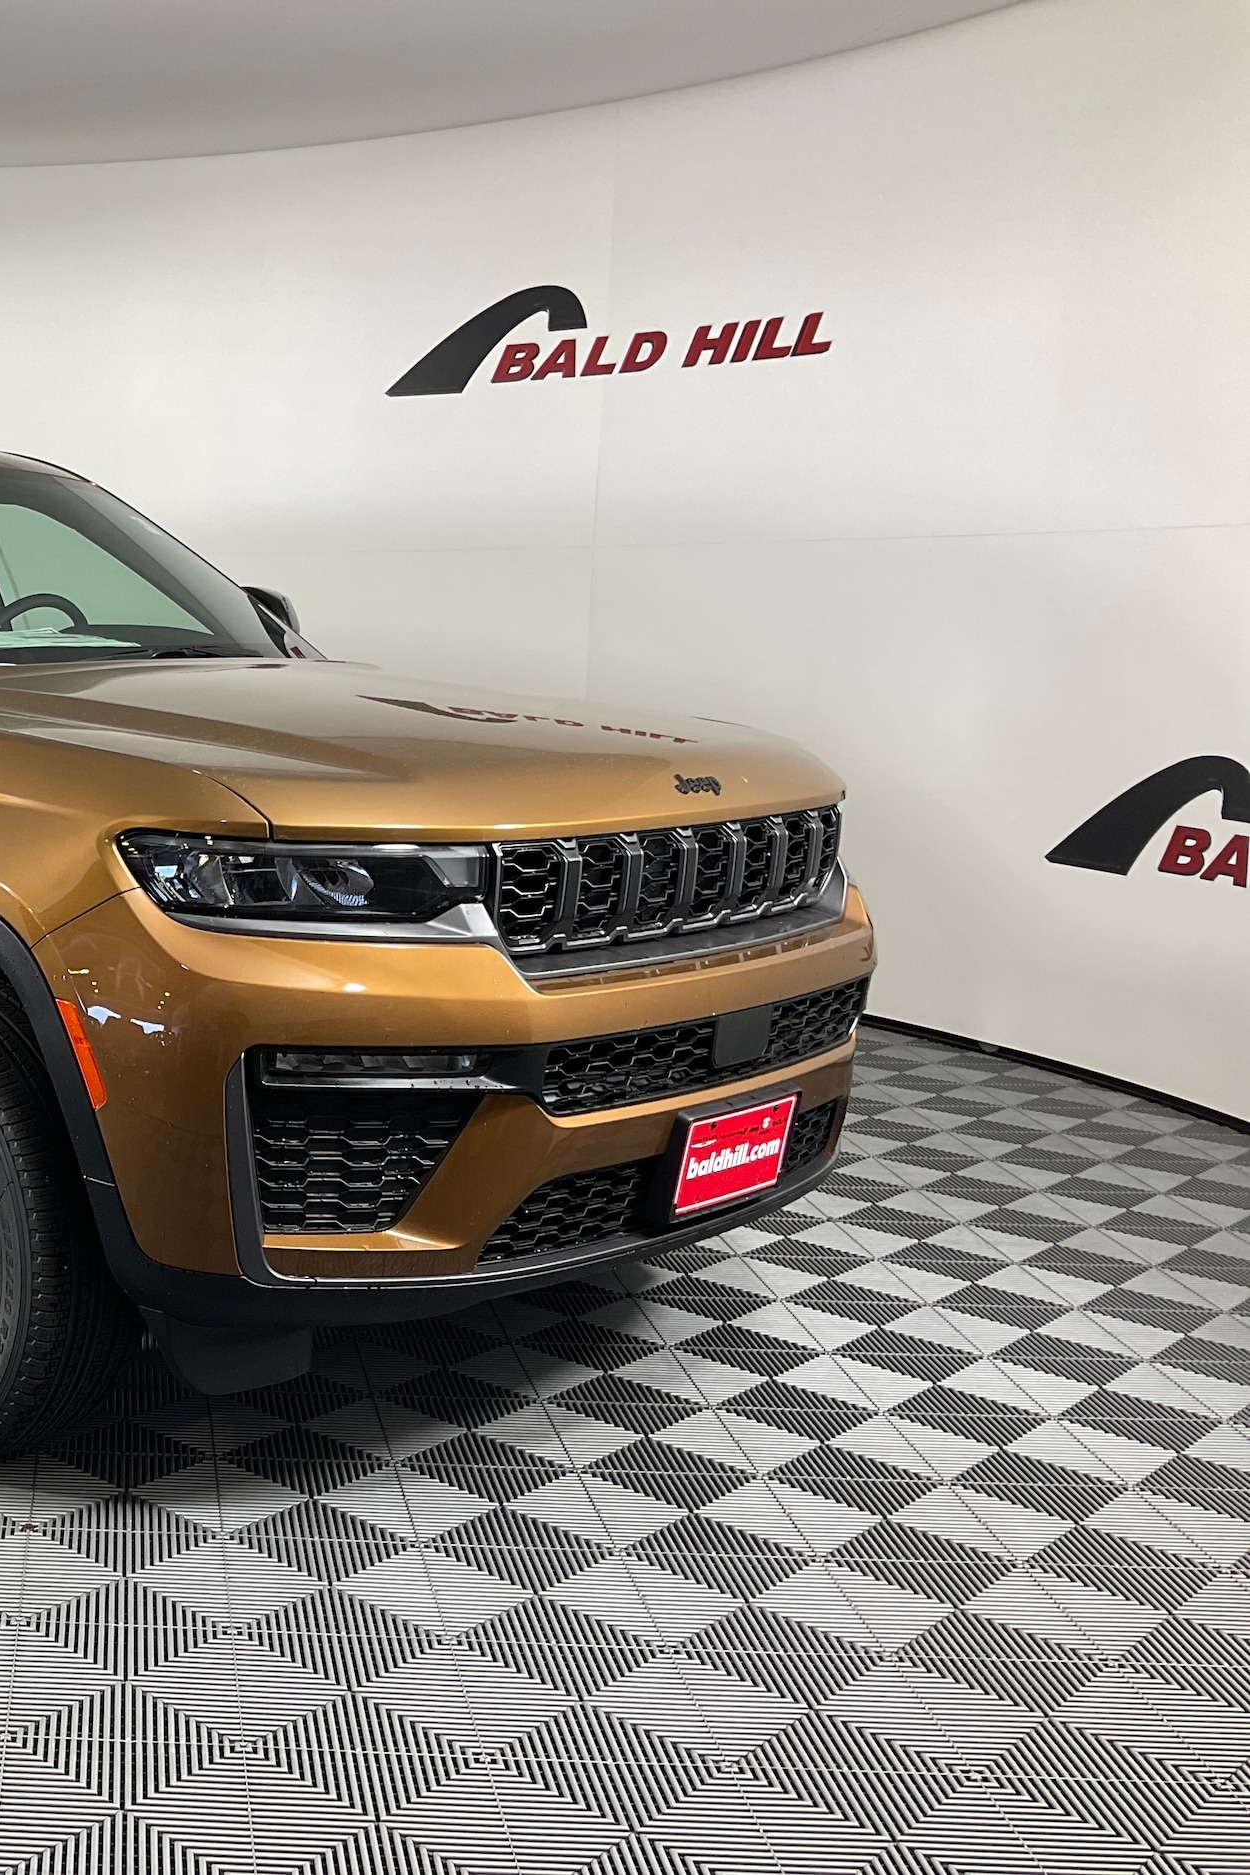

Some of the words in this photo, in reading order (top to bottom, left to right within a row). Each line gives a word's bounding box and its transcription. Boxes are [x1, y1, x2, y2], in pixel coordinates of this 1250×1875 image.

[490, 330, 667, 383] BALD
[682, 311, 832, 367] HILL
[673, 774, 721, 796] Jeep
[686, 1138, 781, 1180] baldhill.com
